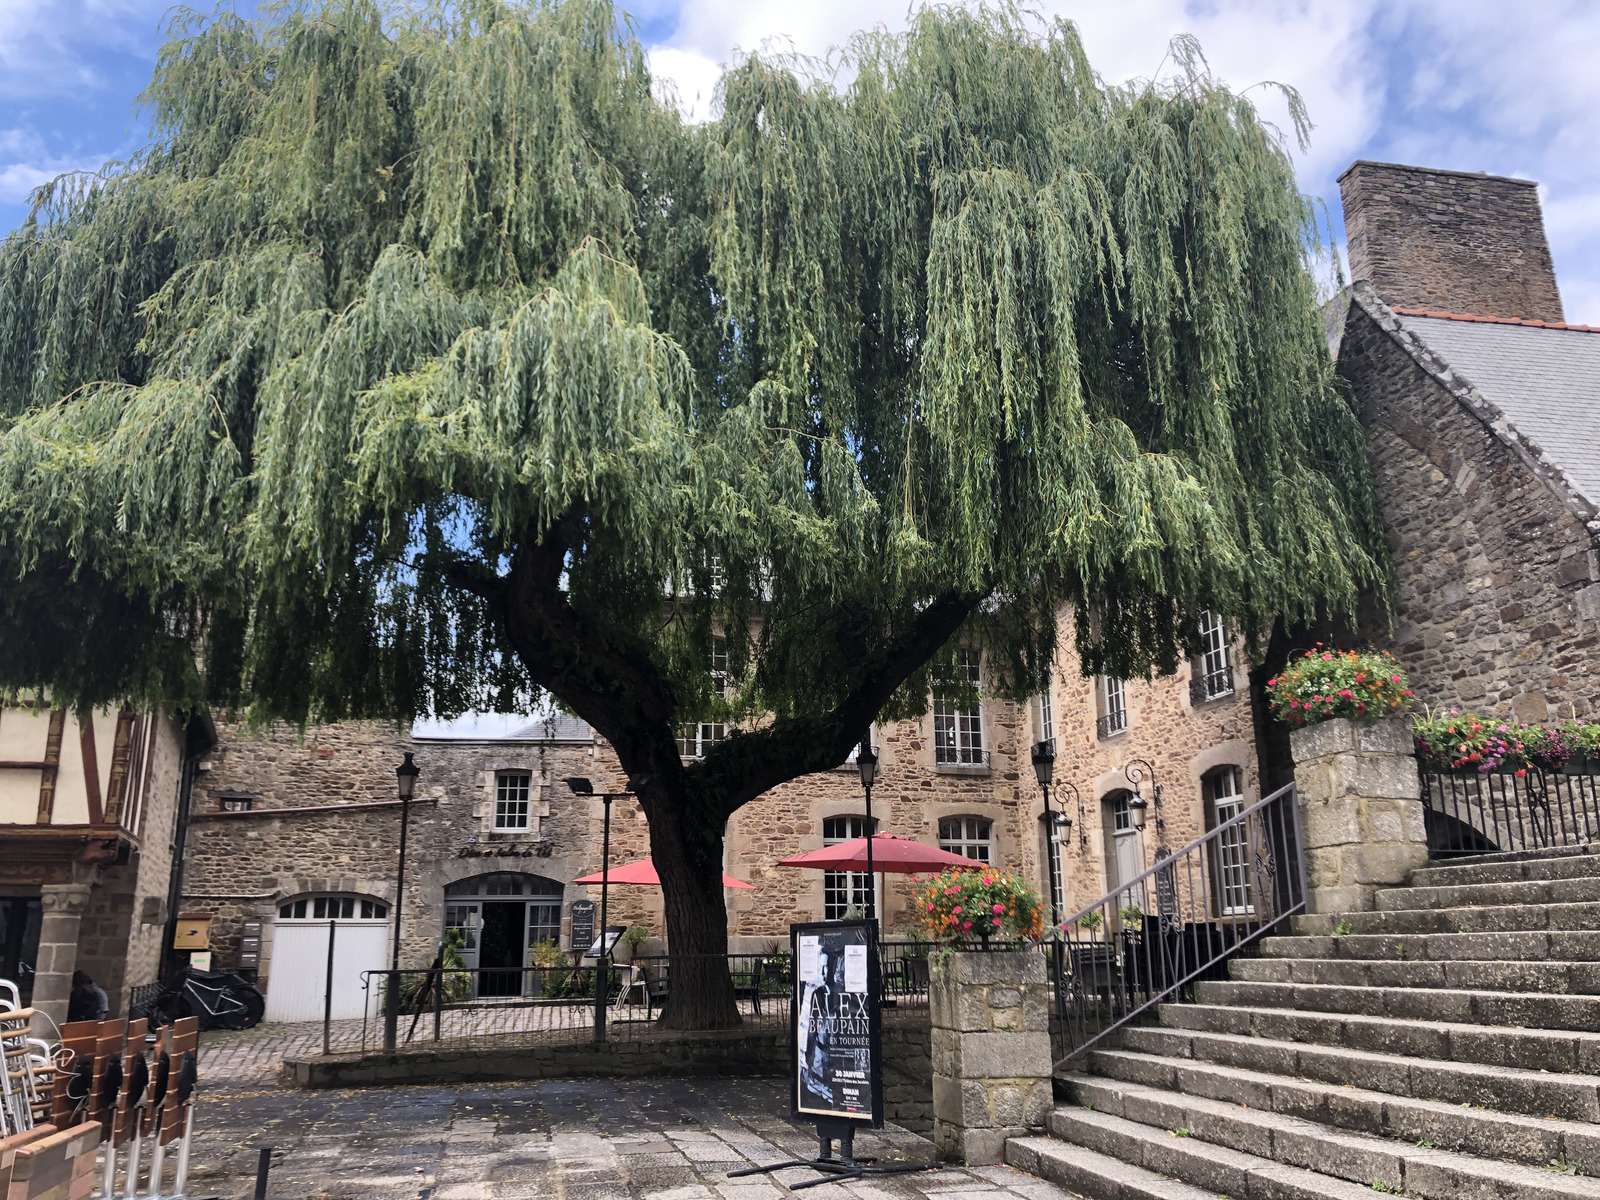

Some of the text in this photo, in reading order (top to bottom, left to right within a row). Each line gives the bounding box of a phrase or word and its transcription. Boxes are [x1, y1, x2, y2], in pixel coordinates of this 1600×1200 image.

[809, 992, 870, 1020] ALEX
[809, 1019, 870, 1035] BEAUPAIN
[829, 1036, 870, 1046] EN TOURNÉE
[843, 1071, 866, 1080] JANVIER
[842, 1088, 860, 1096] DINAN
